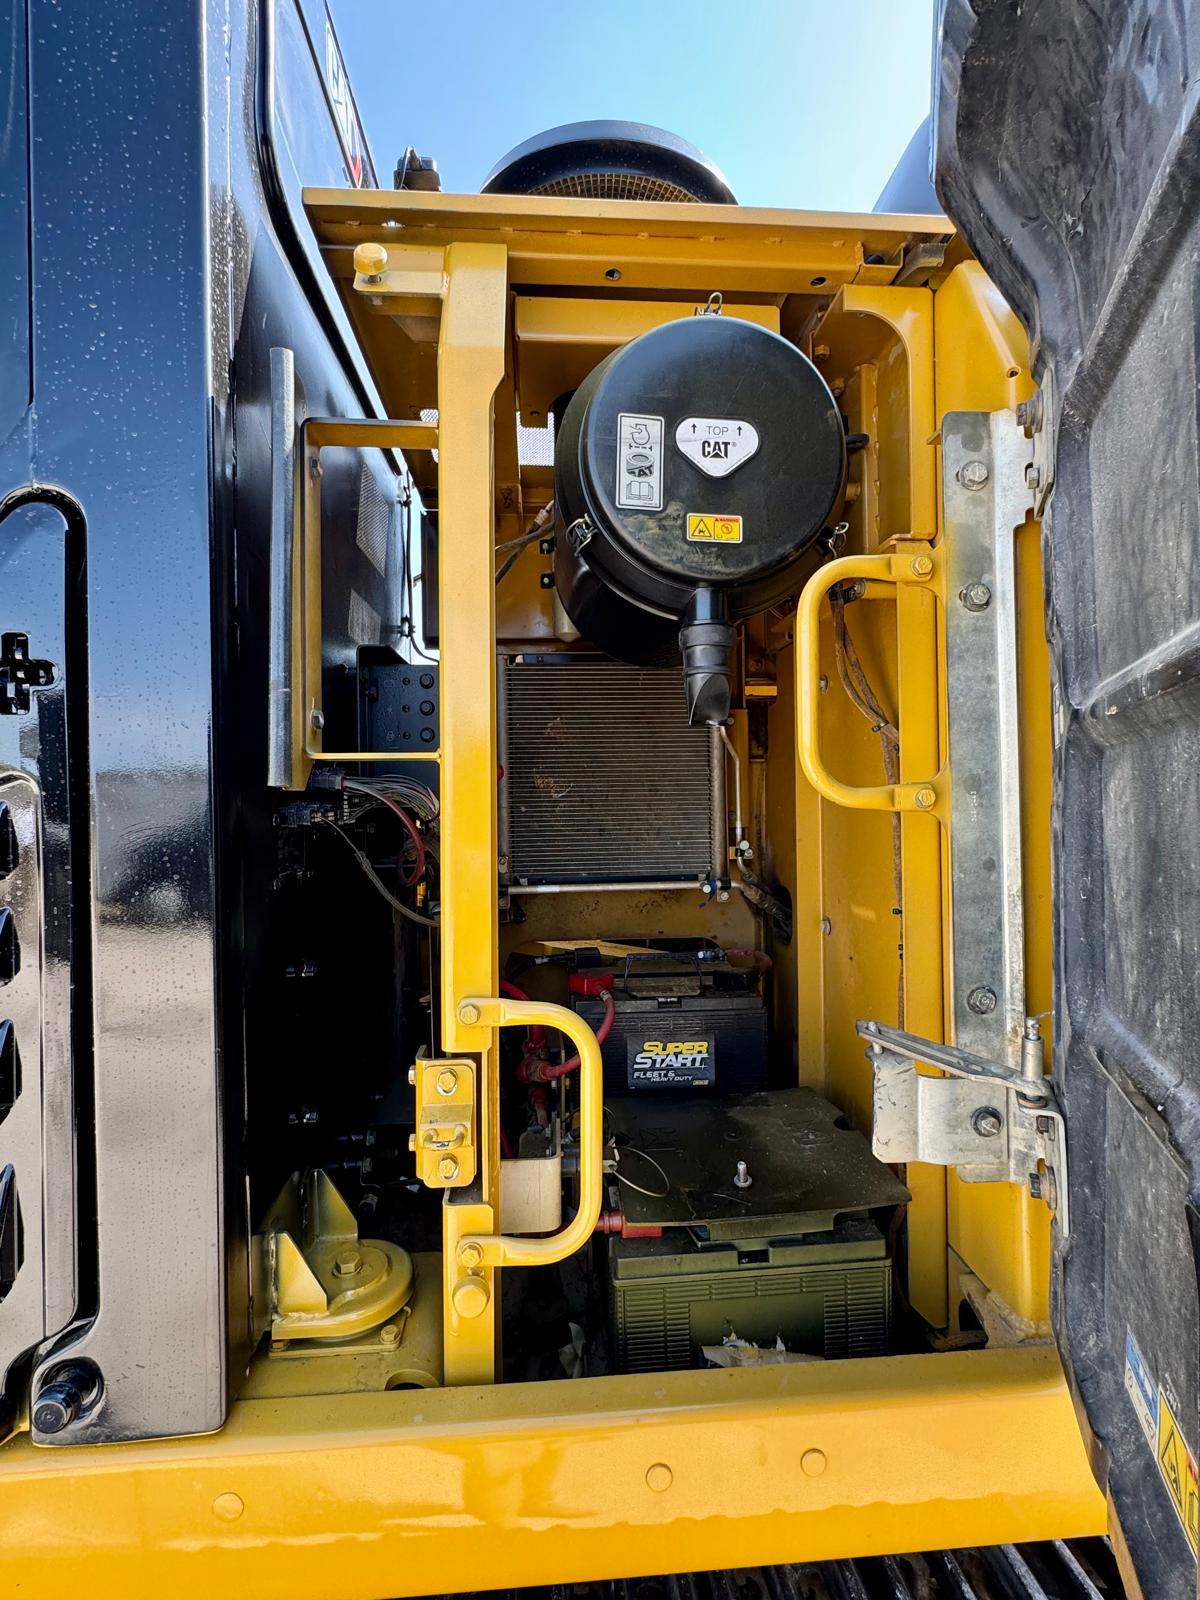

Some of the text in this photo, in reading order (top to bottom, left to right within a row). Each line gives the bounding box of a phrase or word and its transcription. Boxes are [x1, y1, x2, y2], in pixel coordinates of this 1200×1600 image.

[706, 425, 729, 436] TOP
[701, 440, 731, 459] CAT
[643, 1041, 708, 1055] SUPER
[633, 1053, 709, 1068] START
